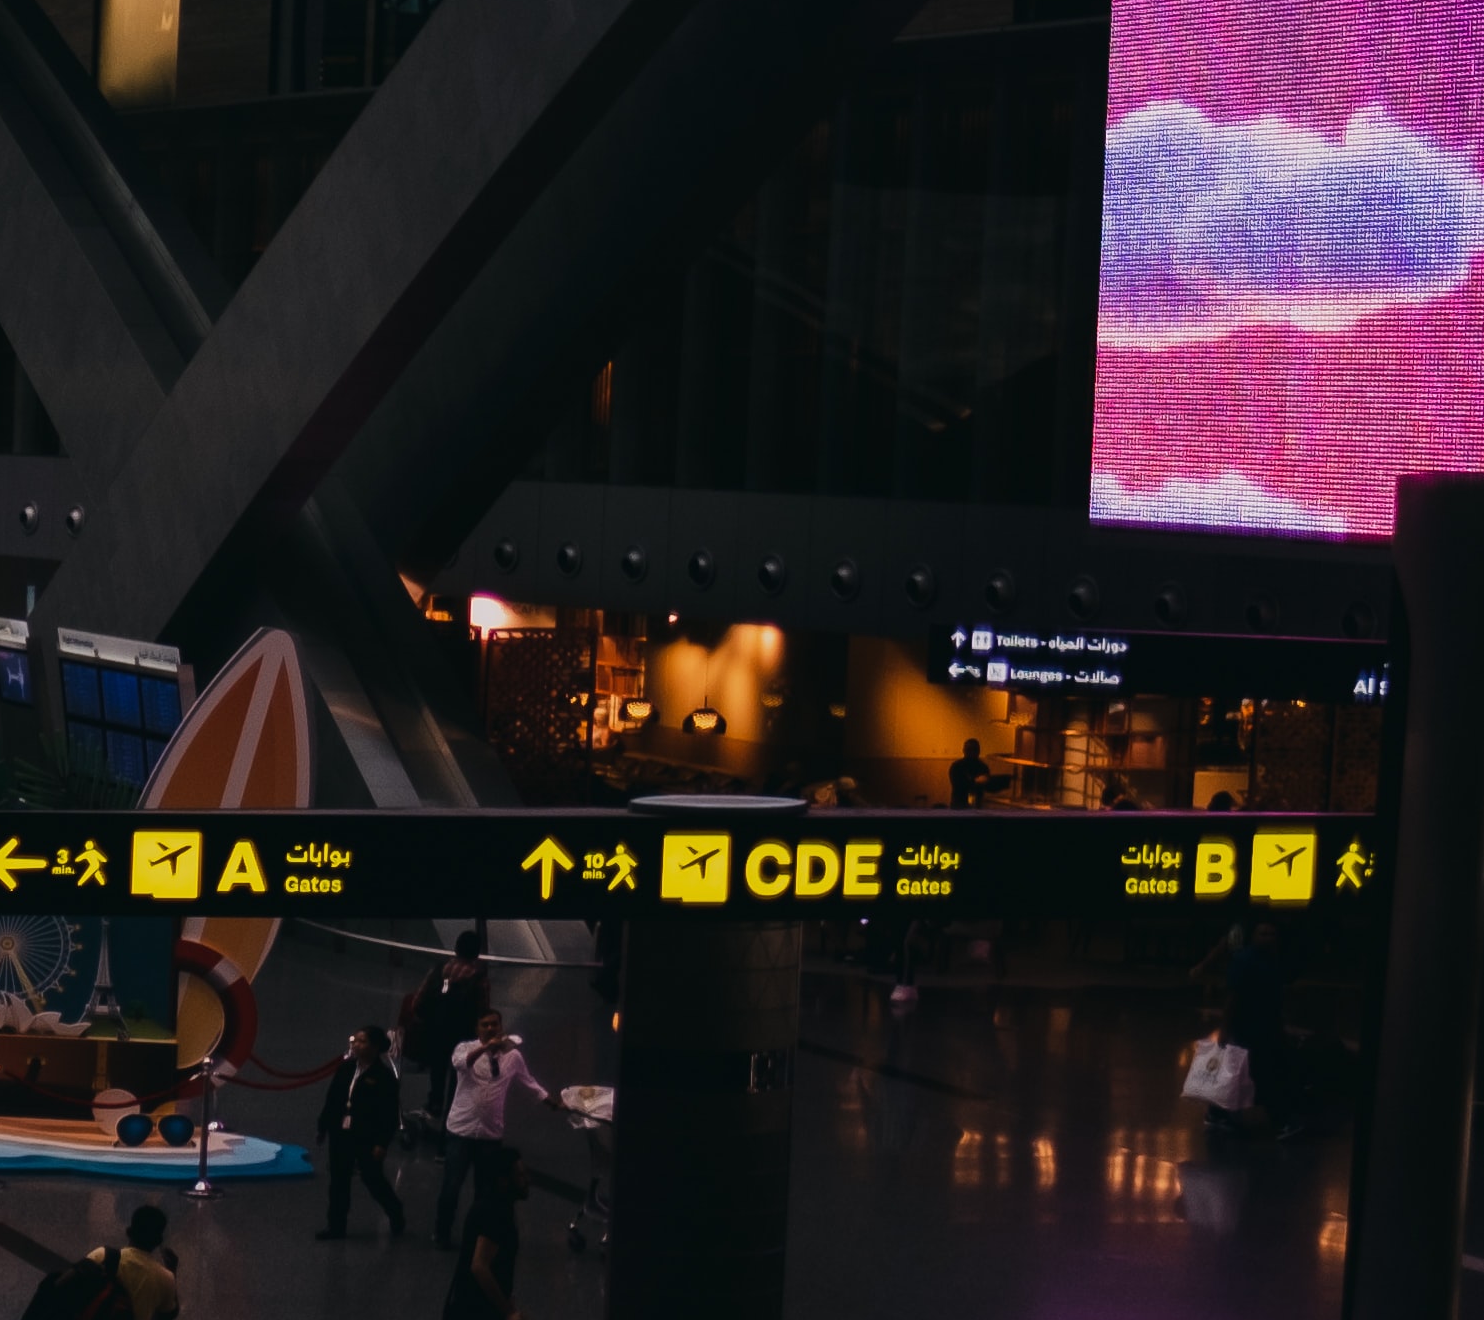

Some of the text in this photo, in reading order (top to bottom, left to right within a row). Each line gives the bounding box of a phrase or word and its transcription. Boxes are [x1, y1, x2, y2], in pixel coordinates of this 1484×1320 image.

[996, 635, 1039, 648] Toilets
[1087, 638, 1128, 654] دورات
[1010, 668, 1120, 684] Lounges صالات
[57, 849, 69, 864] 3
[286, 843, 351, 868] بوابات
[584, 853, 605, 868] 10
[898, 845, 959, 869] بوابات
[1121, 844, 1182, 869] بوابات
[52, 865, 75, 874] min.
[217, 842, 265, 891] A
[746, 844, 881, 895] CDE
[1195, 844, 1234, 893] B
[284, 876, 342, 893] Gates
[897, 878, 951, 895] Gates
[1126, 878, 1178, 894] Gates
